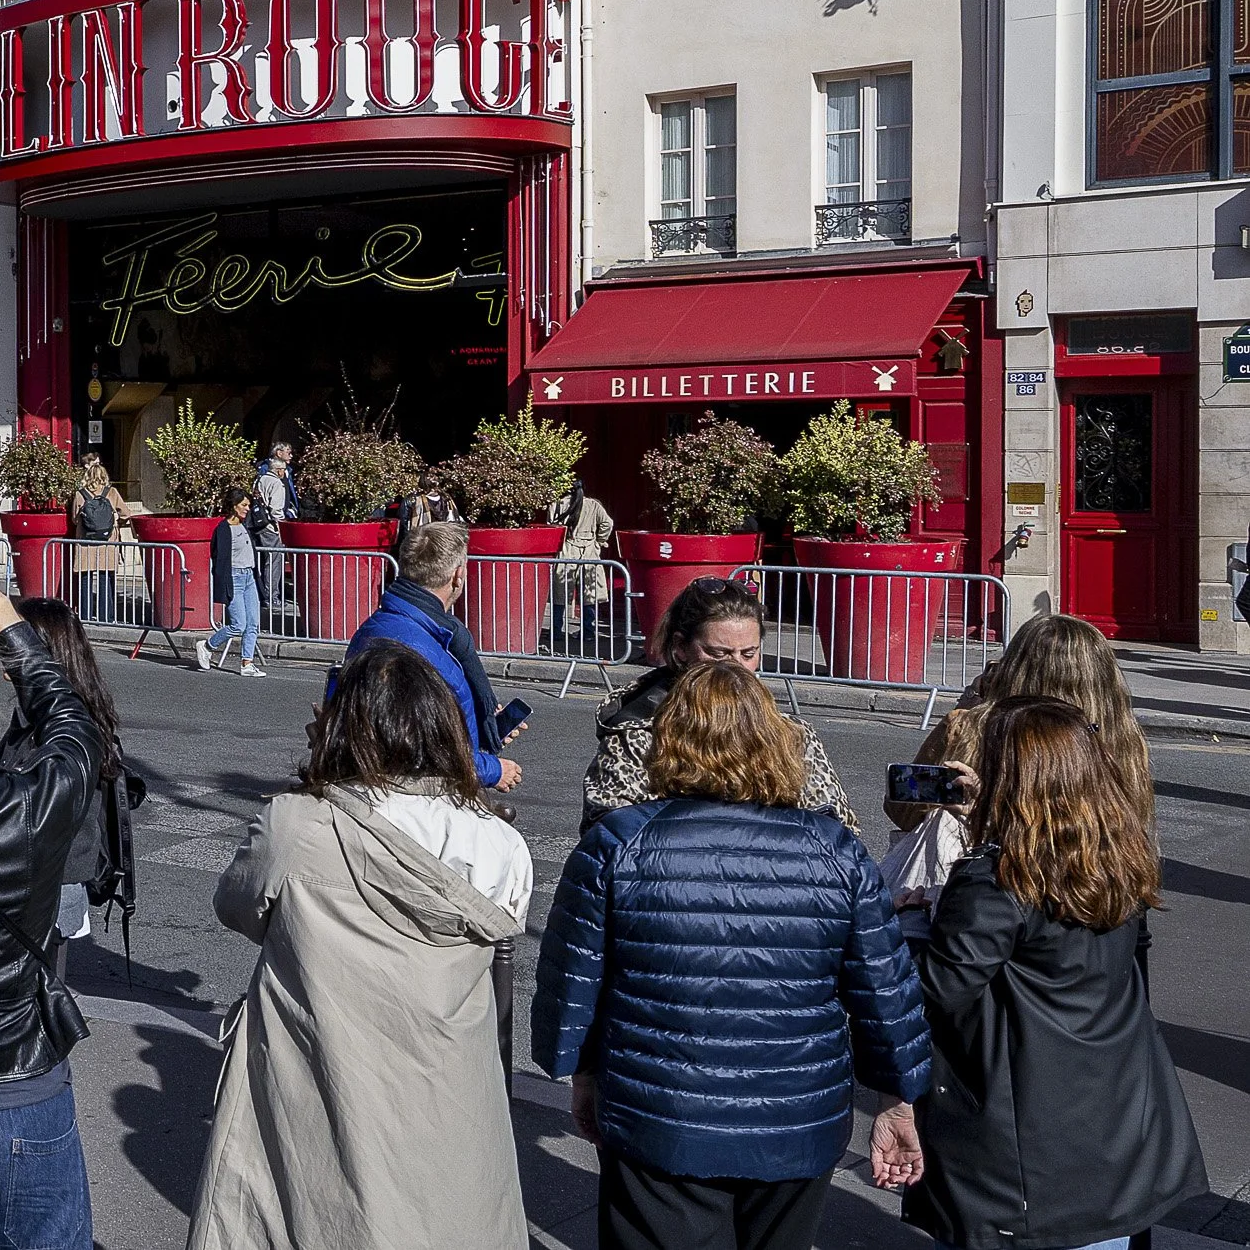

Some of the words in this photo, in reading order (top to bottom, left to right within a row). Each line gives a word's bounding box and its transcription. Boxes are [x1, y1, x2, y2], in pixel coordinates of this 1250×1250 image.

[103, 212, 461, 346] Féerie
[611, 371, 815, 398] BILLETTERIE
[1009, 373, 1025, 382] 82
[1029, 373, 1044, 382] 84
[1018, 385, 1034, 394] 86
